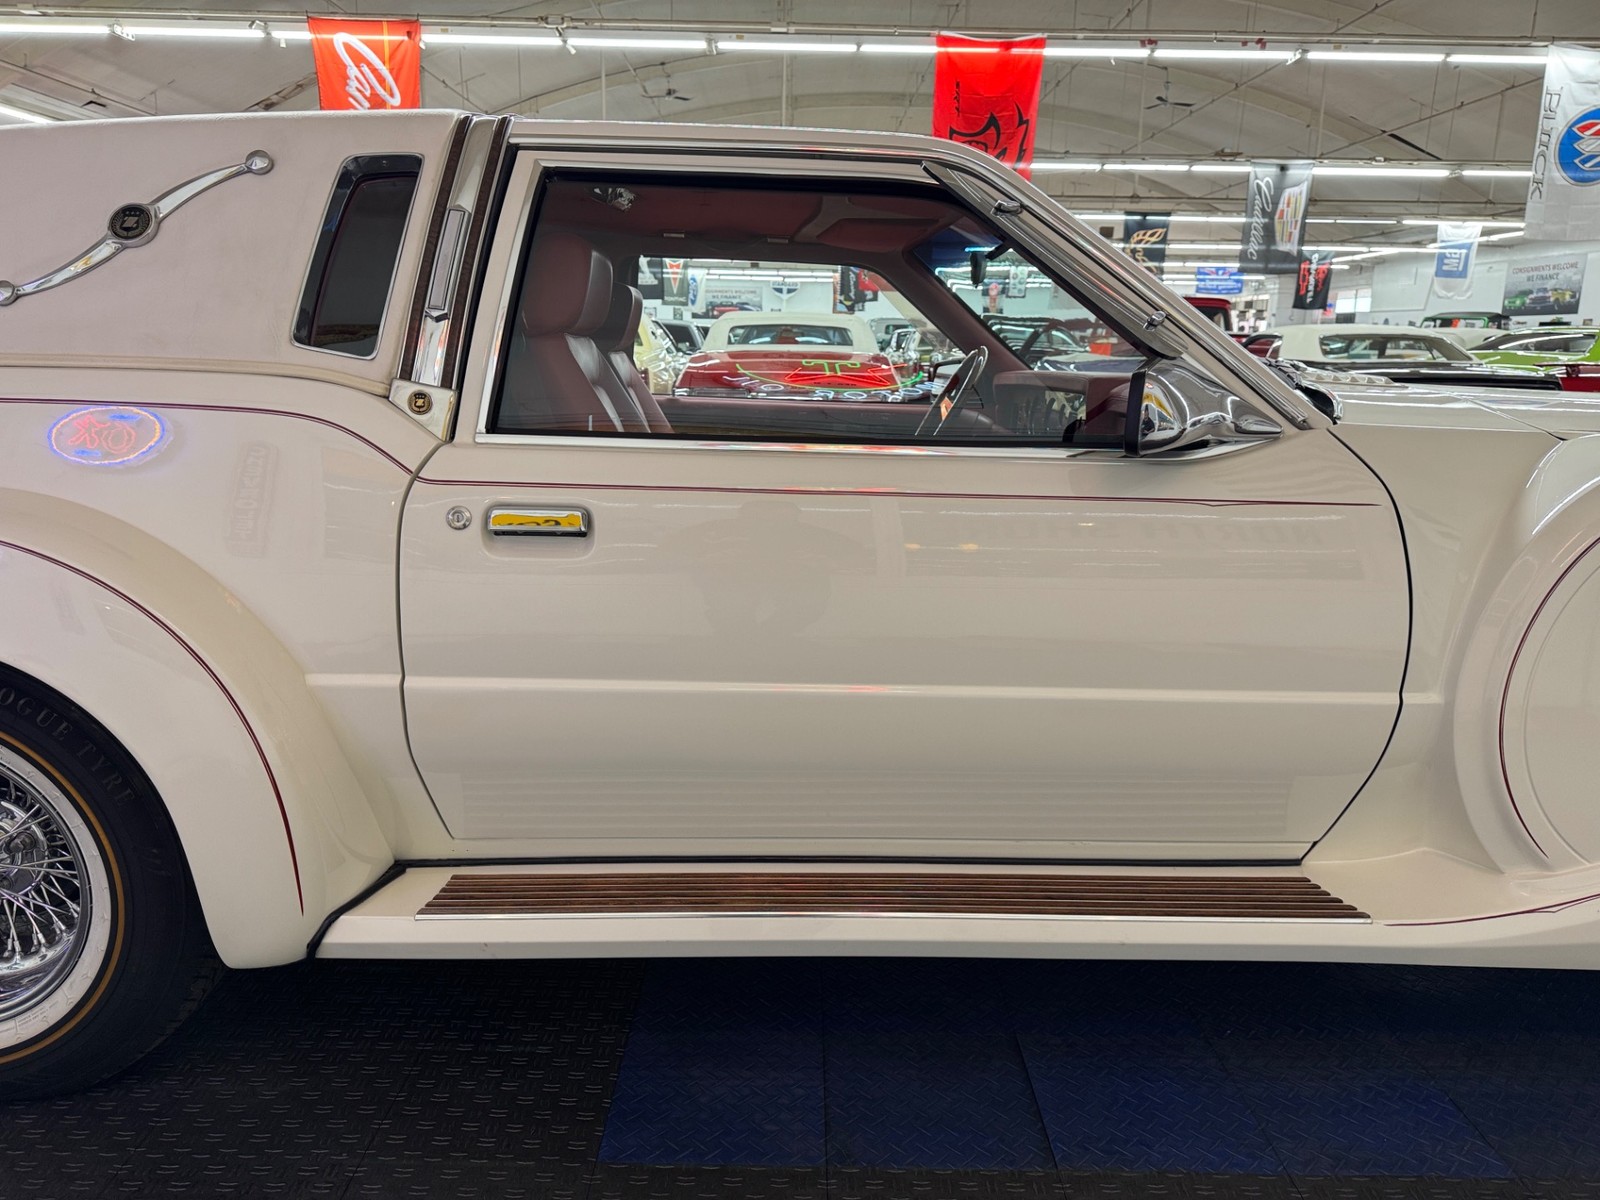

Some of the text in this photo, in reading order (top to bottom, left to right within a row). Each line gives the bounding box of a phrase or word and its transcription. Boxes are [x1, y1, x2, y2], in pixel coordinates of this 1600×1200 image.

[1530, 85, 1563, 200] BUICK
[1247, 177, 1274, 260] Cadillac
[1512, 261, 1579, 275] CONSIGNMENTS WELCOME
[1526, 273, 1560, 282] WE FINANCE
[77, 741, 135, 801] TYRE
